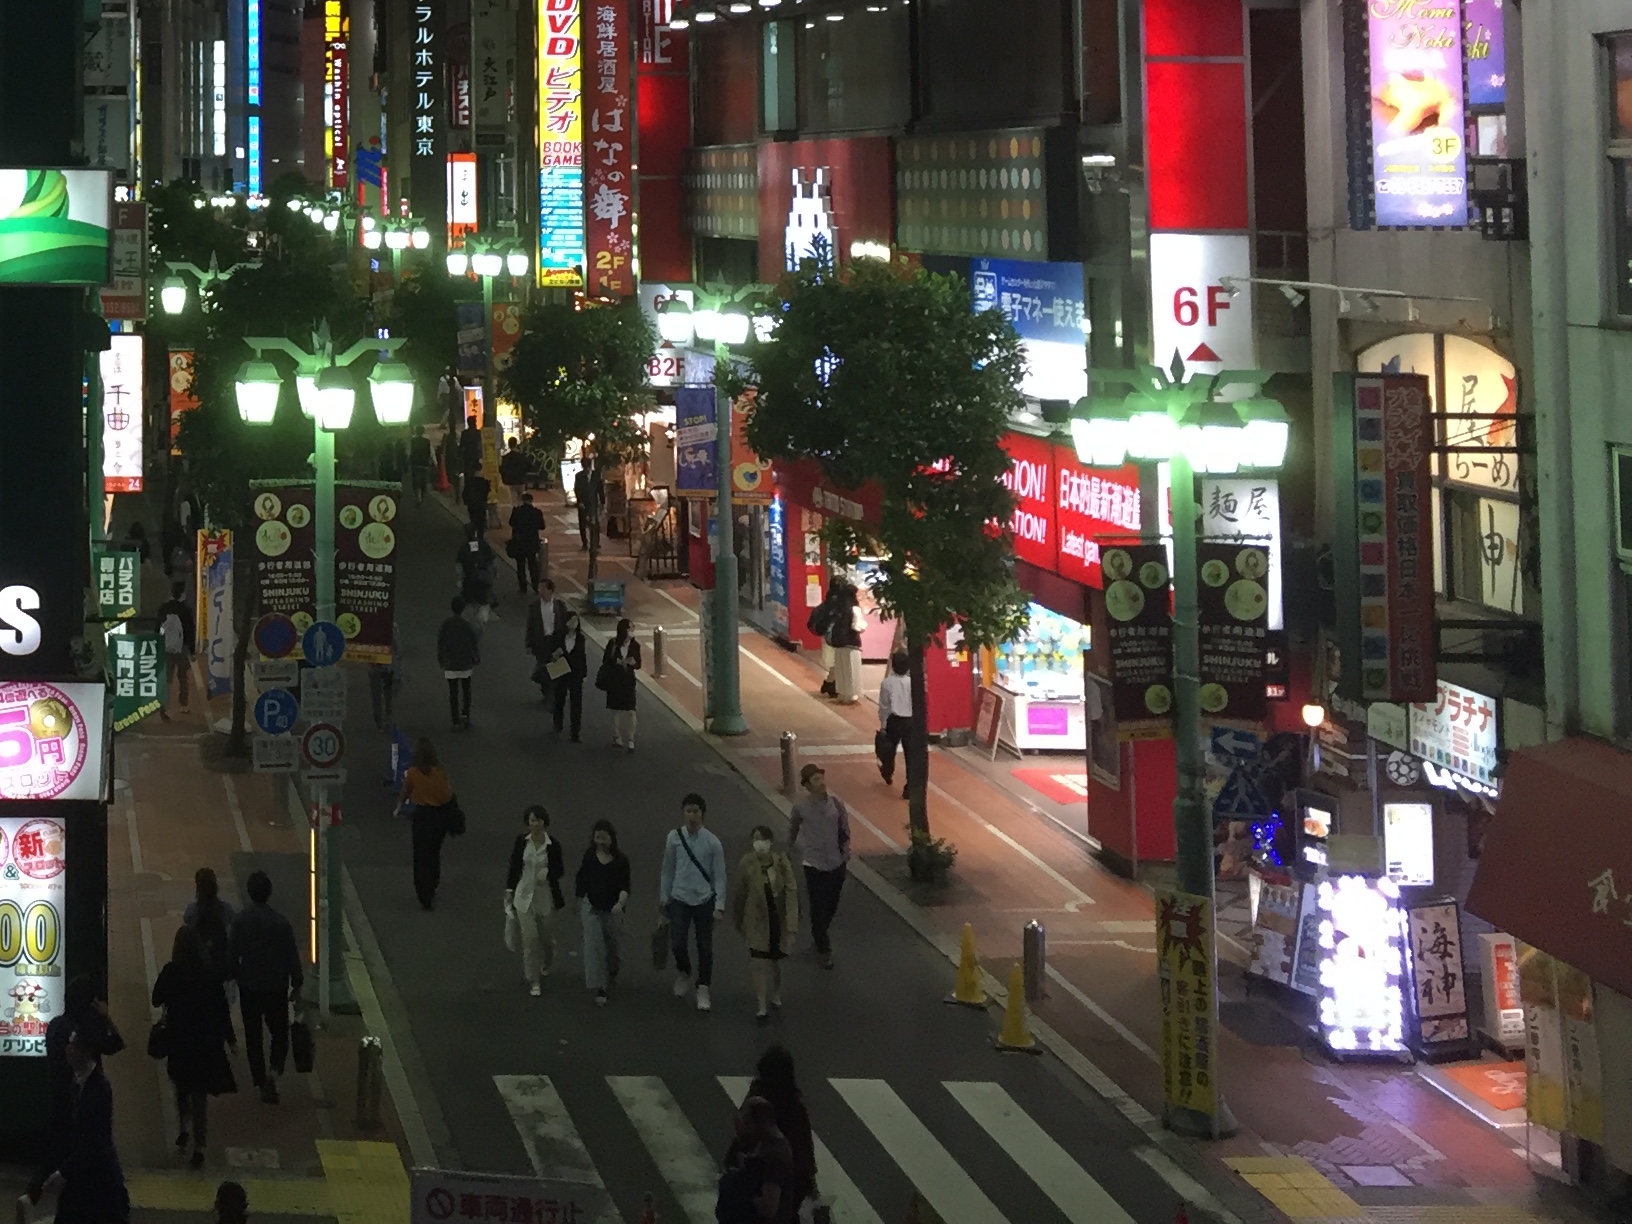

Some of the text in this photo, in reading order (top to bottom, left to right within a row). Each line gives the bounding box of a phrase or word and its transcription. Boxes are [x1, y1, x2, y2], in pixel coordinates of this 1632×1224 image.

[595, 4, 619, 94] 海鮮居酒屋
[542, 141, 582, 153] BOOK
[542, 154, 583, 167] GAME
[1431, 137, 1457, 155] 3F
[590, 107, 629, 229] はなの舞
[596, 250, 625, 269] 2F
[1173, 285, 1232, 328] 6F
[99, 557, 115, 605] 専門店
[118, 557, 134, 605] パチスロ
[115, 640, 135, 697] 専門店
[139, 639, 159, 697] パチスロ
[263, 699, 281, 728] P
[312, 736, 337, 757] 30
[18, 831, 44, 859] 新
[1416, 921, 1458, 1005] 海神
